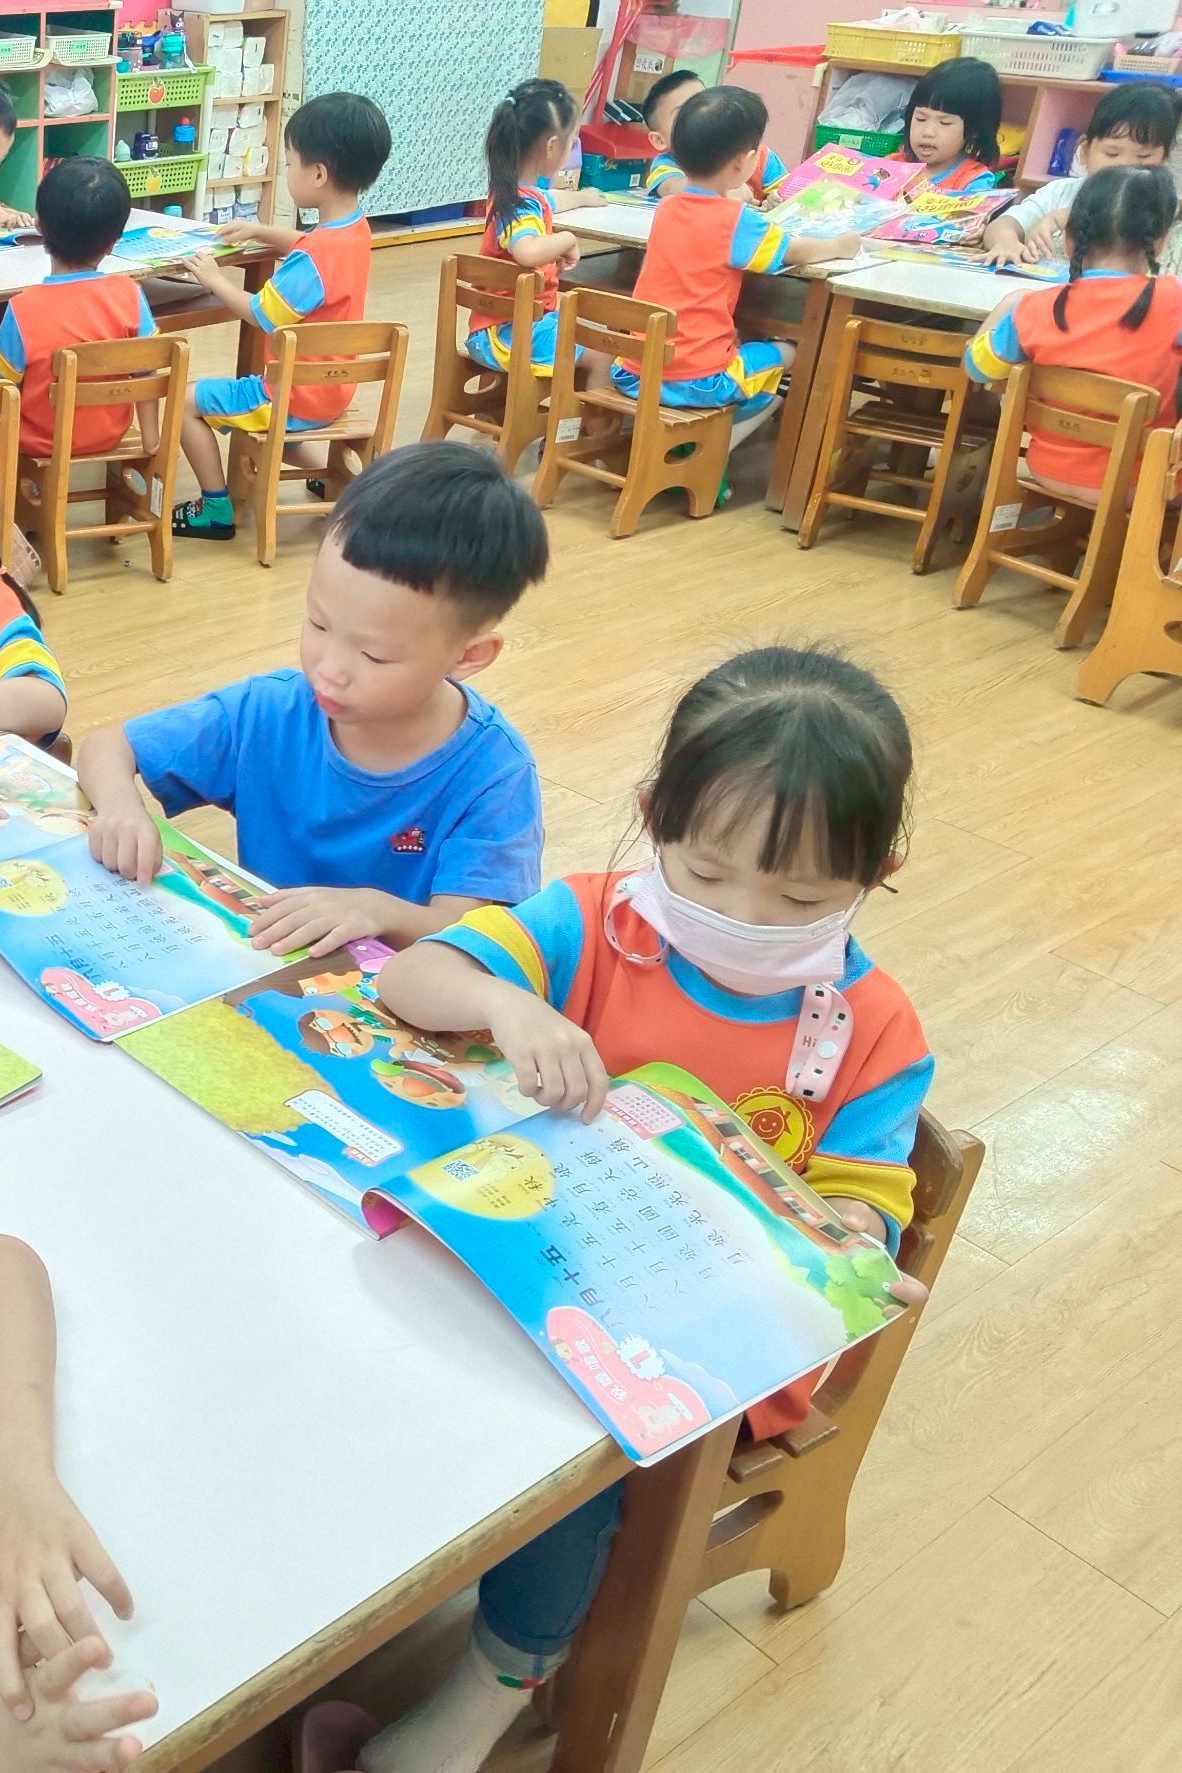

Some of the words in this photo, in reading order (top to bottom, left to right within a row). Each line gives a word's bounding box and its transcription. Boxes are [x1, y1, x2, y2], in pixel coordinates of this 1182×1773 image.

[802, 1035, 818, 1048] Hi
[540, 1244, 625, 1329] 八月十五
